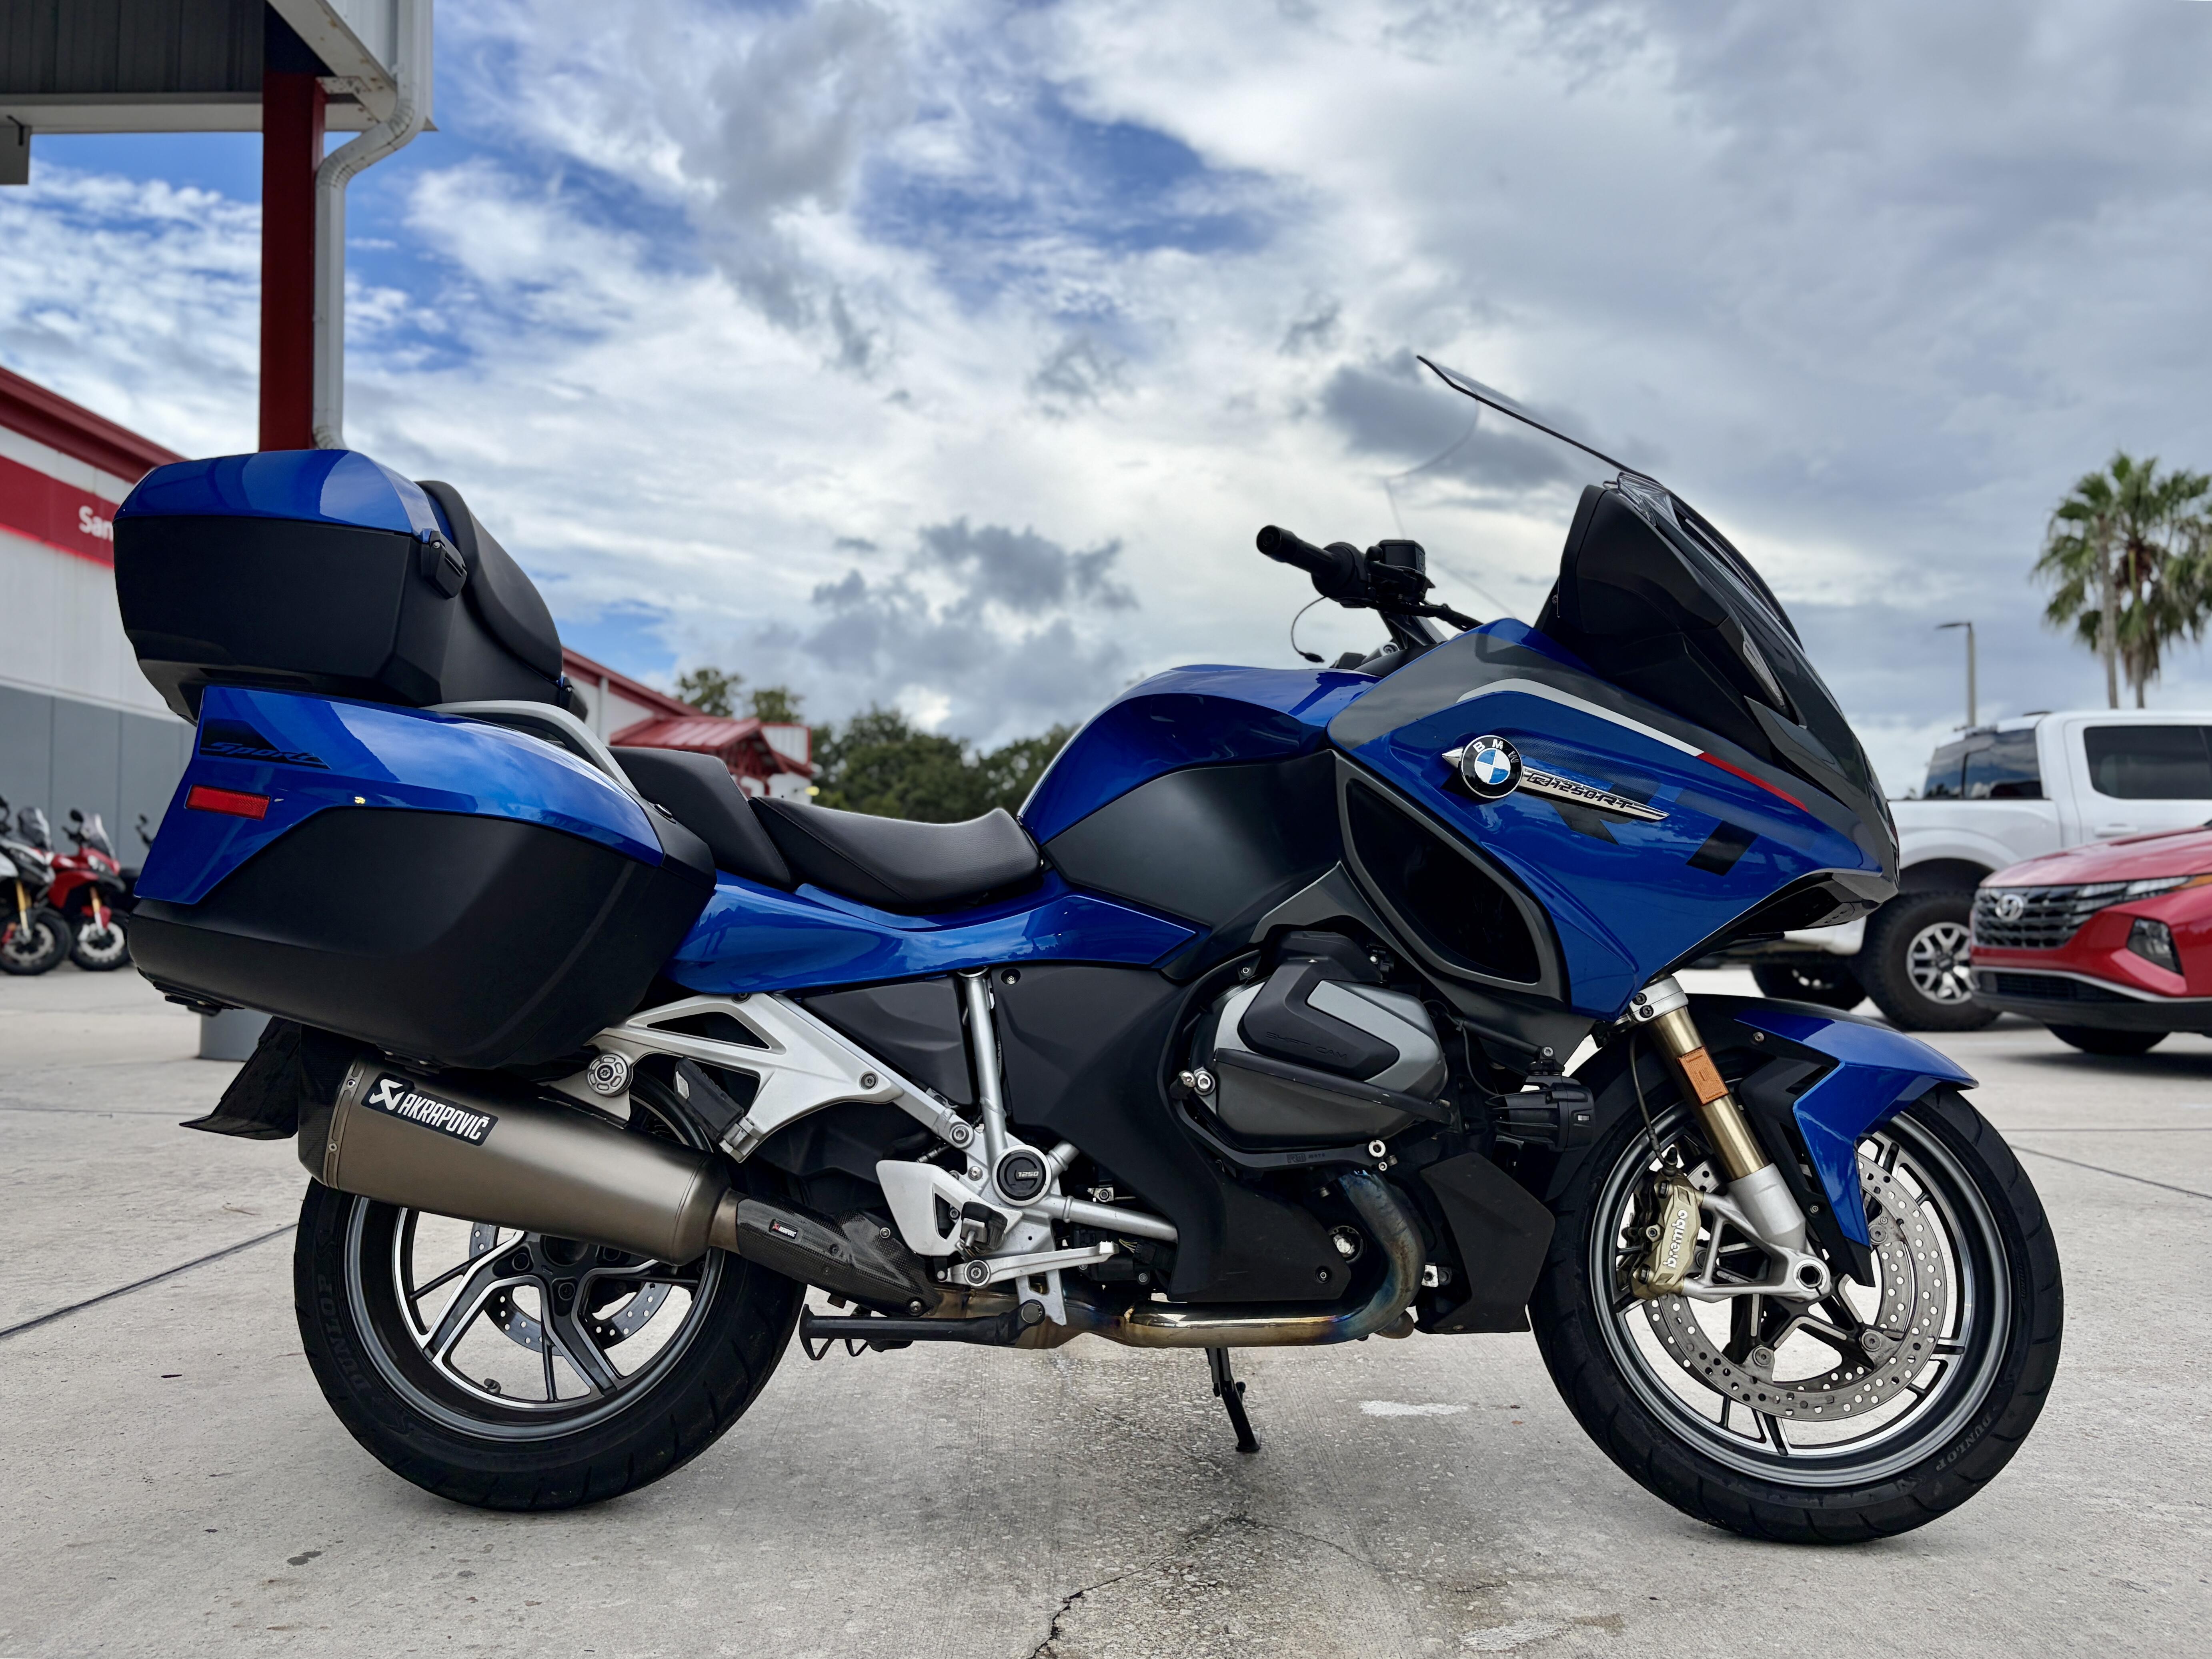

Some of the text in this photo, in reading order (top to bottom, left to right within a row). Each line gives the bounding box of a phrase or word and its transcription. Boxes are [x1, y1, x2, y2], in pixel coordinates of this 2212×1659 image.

[1473, 739, 1519, 763] BMW
[1663, 1209, 1688, 1268] brembo
[318, 1274, 372, 1391] DUNLOP
[1936, 1412, 1993, 1472] DUNLOP
